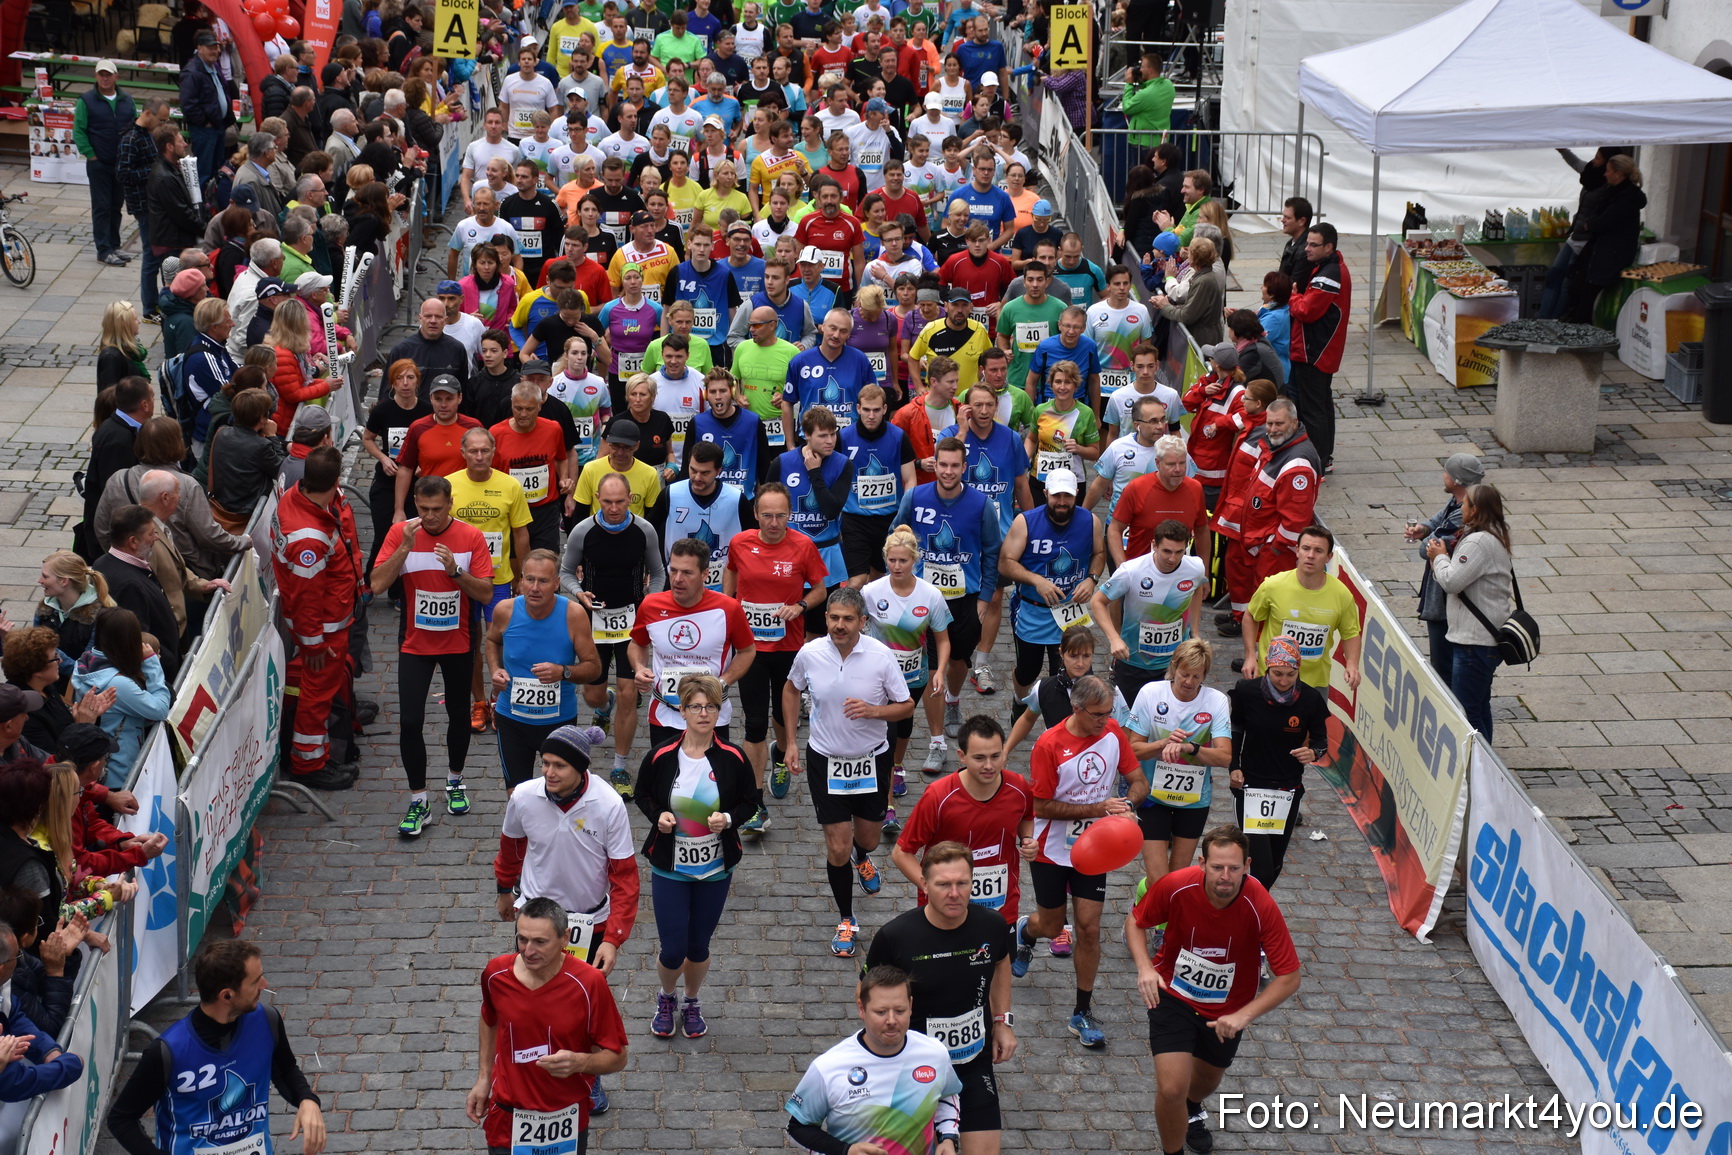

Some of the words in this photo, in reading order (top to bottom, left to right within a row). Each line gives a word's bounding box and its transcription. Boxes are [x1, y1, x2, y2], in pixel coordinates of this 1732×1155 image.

[441, 0, 474, 10] Block
[1056, 8, 1088, 19] Block
[444, 14, 468, 45] A
[636, 31, 653, 41] 2454
[1060, 24, 1083, 55] A
[860, 154, 881, 164] 2008
[767, 165, 783, 175] MAX
[679, 279, 696, 292] 14
[622, 318, 638, 328] RUN
[325, 322, 336, 343] BMW
[1026, 330, 1040, 341] 40
[800, 365, 824, 379] 60
[1101, 374, 1128, 387] 3063
[847, 446, 859, 460] 7
[1041, 459, 1071, 474] 2475
[523, 476, 539, 489] 48
[786, 473, 800, 488] 6
[861, 483, 893, 498] 2279
[865, 498, 890, 506] Alexander
[676, 507, 690, 524] 7
[914, 507, 937, 525] 12
[1031, 539, 1053, 555] 13
[932, 571, 957, 588] 266
[420, 600, 457, 616] 2095
[607, 607, 628, 615] Neumarkt
[1061, 603, 1084, 622] 271
[425, 618, 450, 626] Michael
[602, 614, 628, 631] 163
[746, 611, 782, 627] 2564
[605, 631, 624, 639] Martin
[1144, 628, 1180, 645] 3078
[516, 688, 556, 706] 2289
[833, 760, 872, 778] 2046
[1157, 764, 1173, 773] PARTL
[1174, 767, 1198, 776] Neumarkt
[843, 780, 861, 790] Josef
[1163, 773, 1194, 791] 273
[1166, 793, 1185, 803] Heidi
[1246, 791, 1262, 799] PARTL
[1260, 800, 1276, 817] 61
[690, 838, 716, 846] Neumarkt
[678, 843, 720, 864] 3037
[973, 870, 1000, 878] Neumarkt
[971, 876, 1003, 897] 361
[952, 948, 977, 957] TRIATHLON
[1179, 953, 1198, 968] PARTL
[1198, 962, 1227, 975] Neumarkt
[1180, 963, 1229, 991] 2406
[1186, 985, 1212, 999] Daniel
[927, 1021, 950, 1030] PARTL
[950, 1014, 976, 1028] Neumarkt
[935, 1021, 981, 1045] 2688
[521, 1050, 539, 1060] DEHN
[176, 1063, 218, 1094] 22
[848, 1087, 871, 1096] PARTL
[515, 1112, 537, 1122] PARTL
[538, 1111, 569, 1123] Neumarkt
[519, 1117, 573, 1144] 2408
